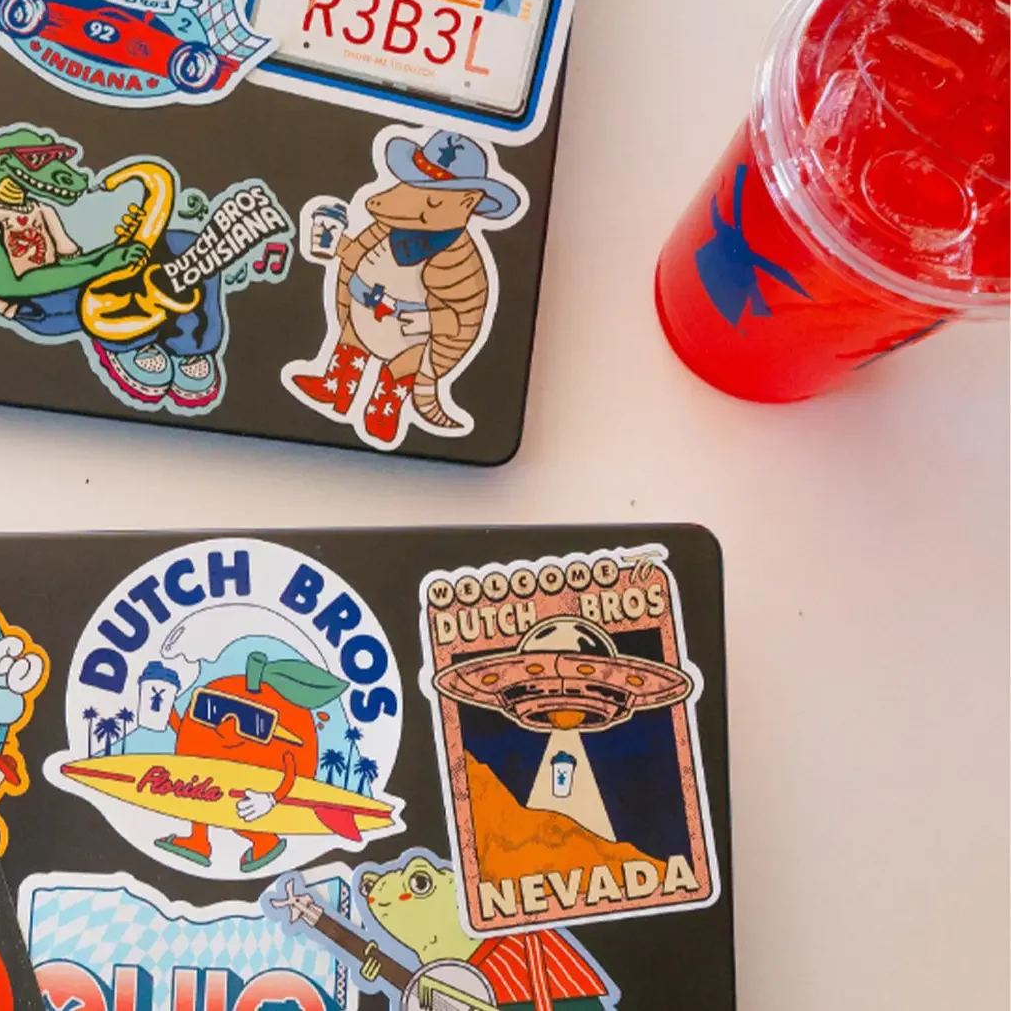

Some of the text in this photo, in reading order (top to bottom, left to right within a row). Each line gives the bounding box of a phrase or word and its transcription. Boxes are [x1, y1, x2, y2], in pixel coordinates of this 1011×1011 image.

[89, 21, 116, 42] 92
[178, 17, 192, 34] 2
[41, 48, 143, 92] INDIANA
[164, 185, 270, 277] DUTCH BROS
[172, 207, 285, 293] LOUISIANA
[430, 561, 616, 603] WELCOME
[79, 550, 397, 723] DUTCH BROS
[436, 584, 665, 644] DUTCH BROS
[137, 765, 224, 802] Florida
[477, 855, 701, 920] NEVADA
